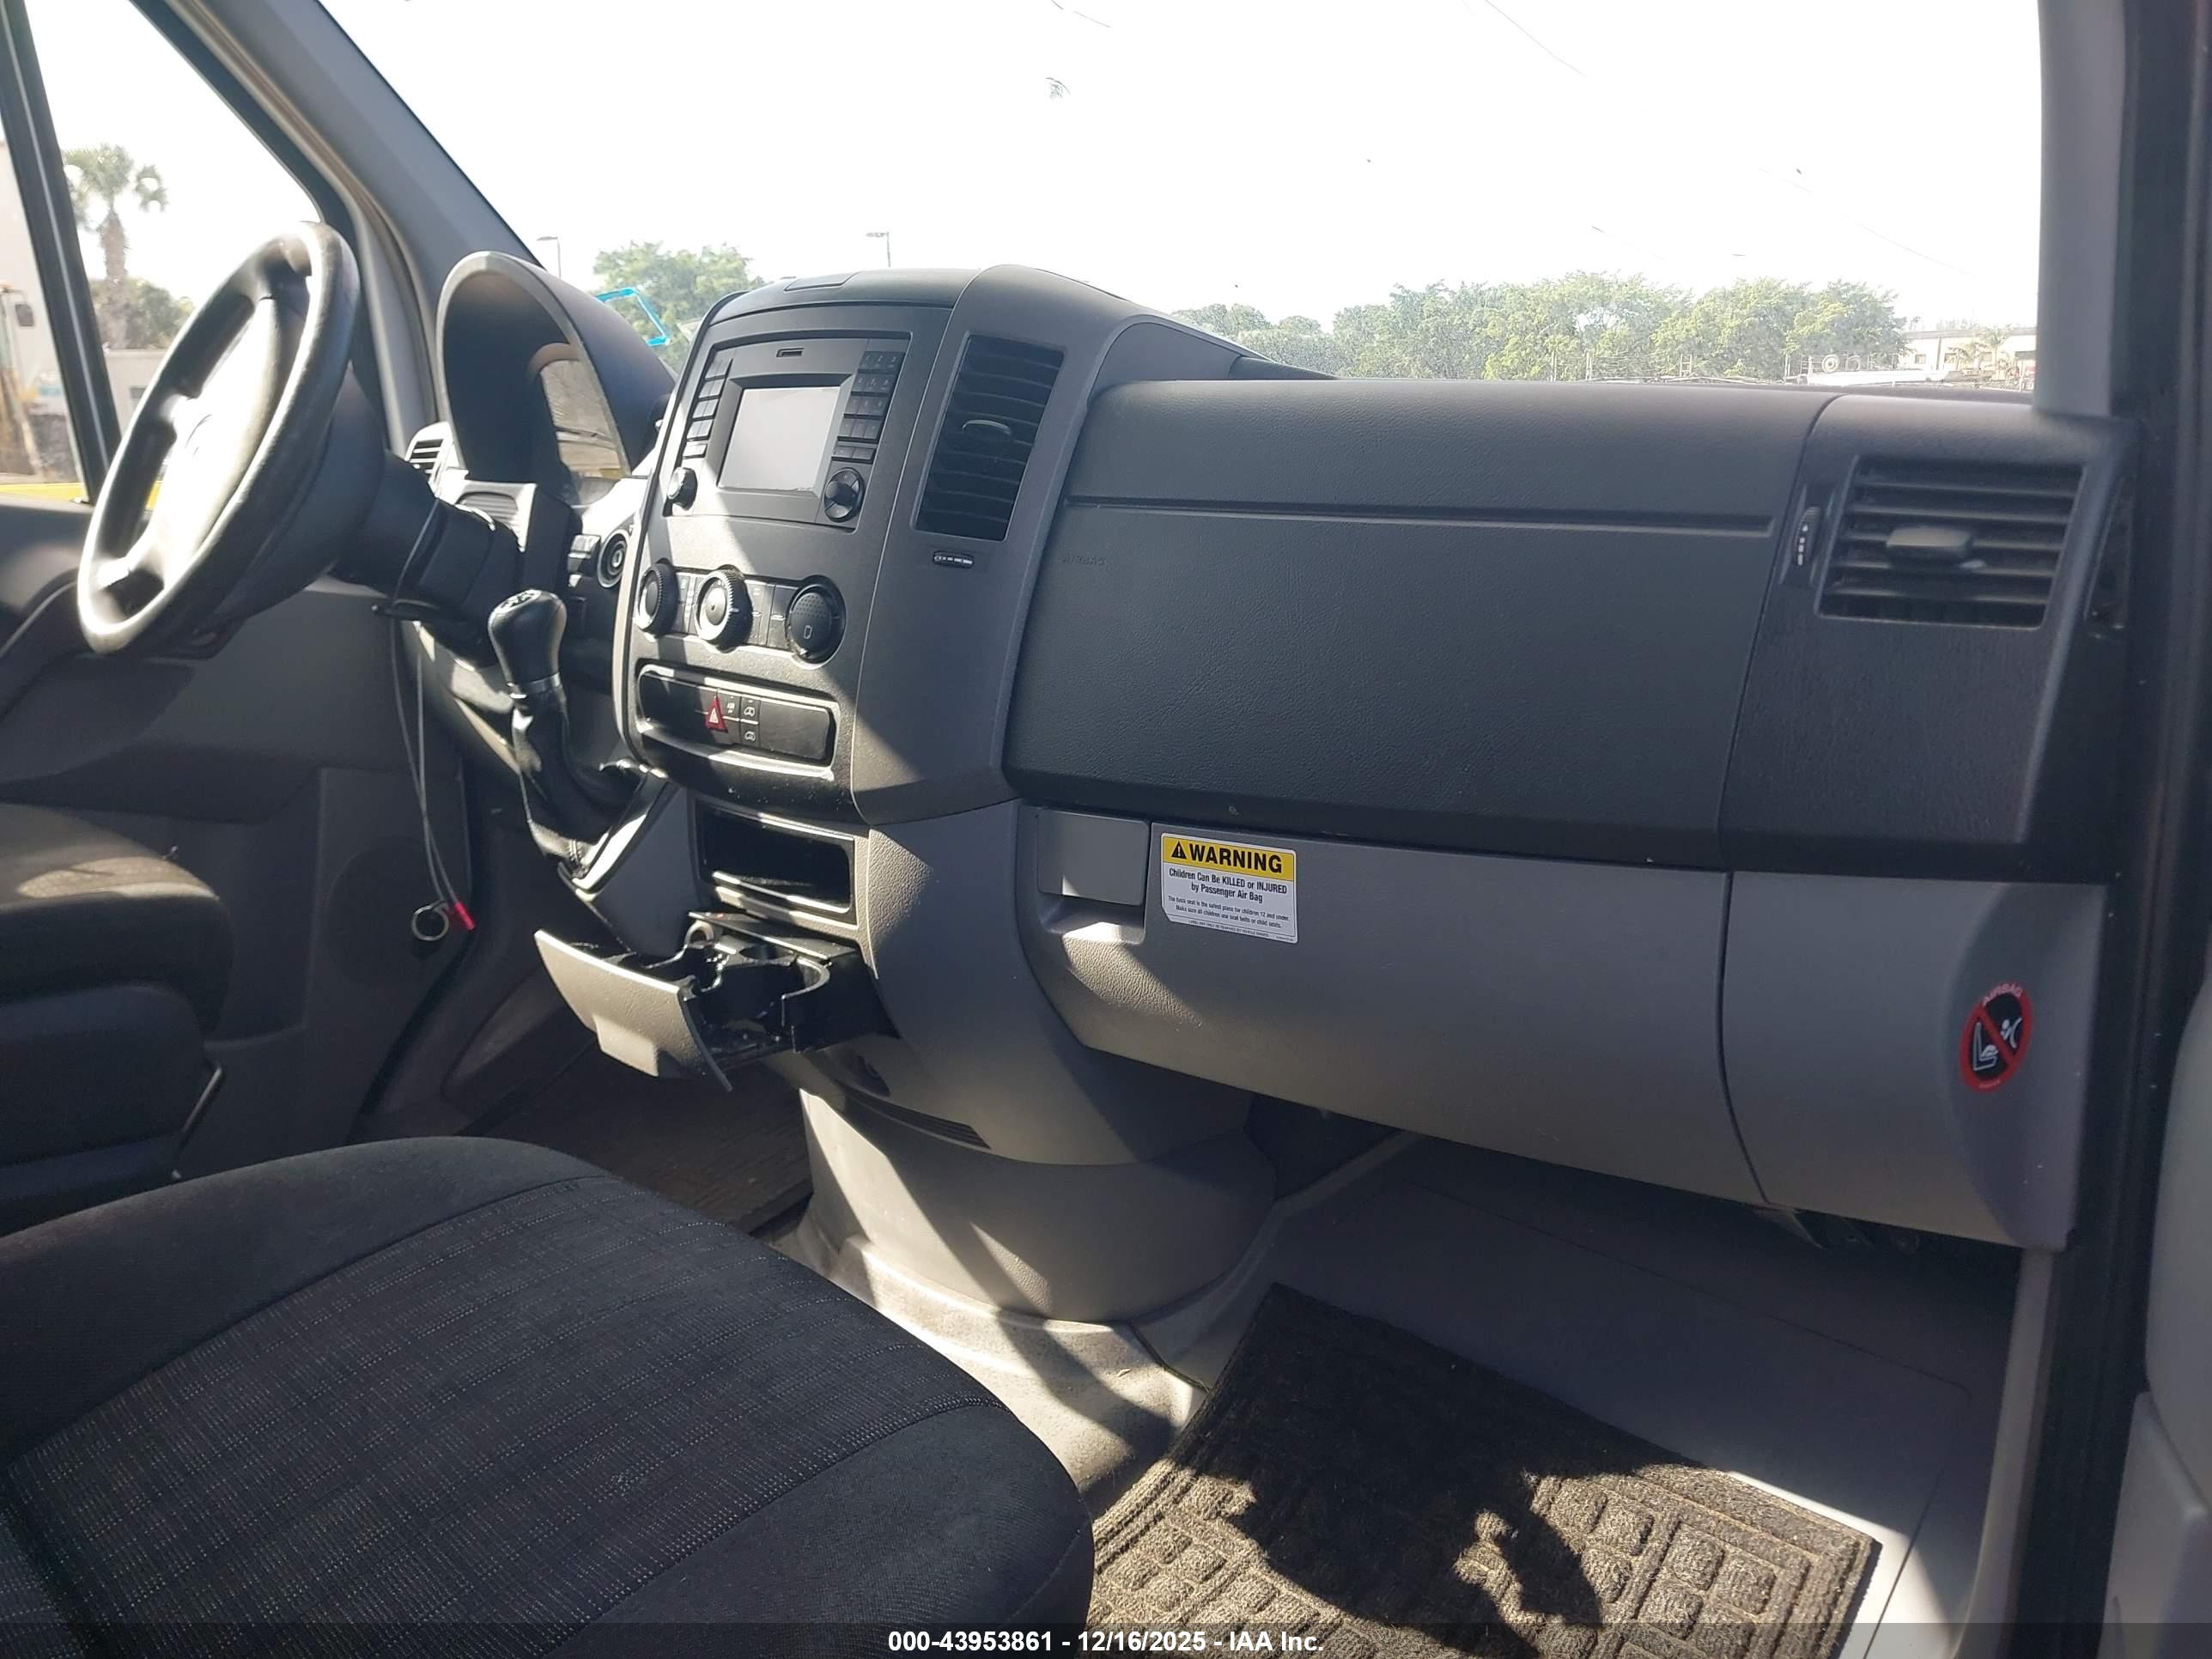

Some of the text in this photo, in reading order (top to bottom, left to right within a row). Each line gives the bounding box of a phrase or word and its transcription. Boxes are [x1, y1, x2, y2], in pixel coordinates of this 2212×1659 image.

[1188, 843, 1282, 874] WARNING
[1169, 867, 1287, 894] Children Can Be KILLED or INJURED
[1191, 881, 1263, 904] by Passenger Air Bag
